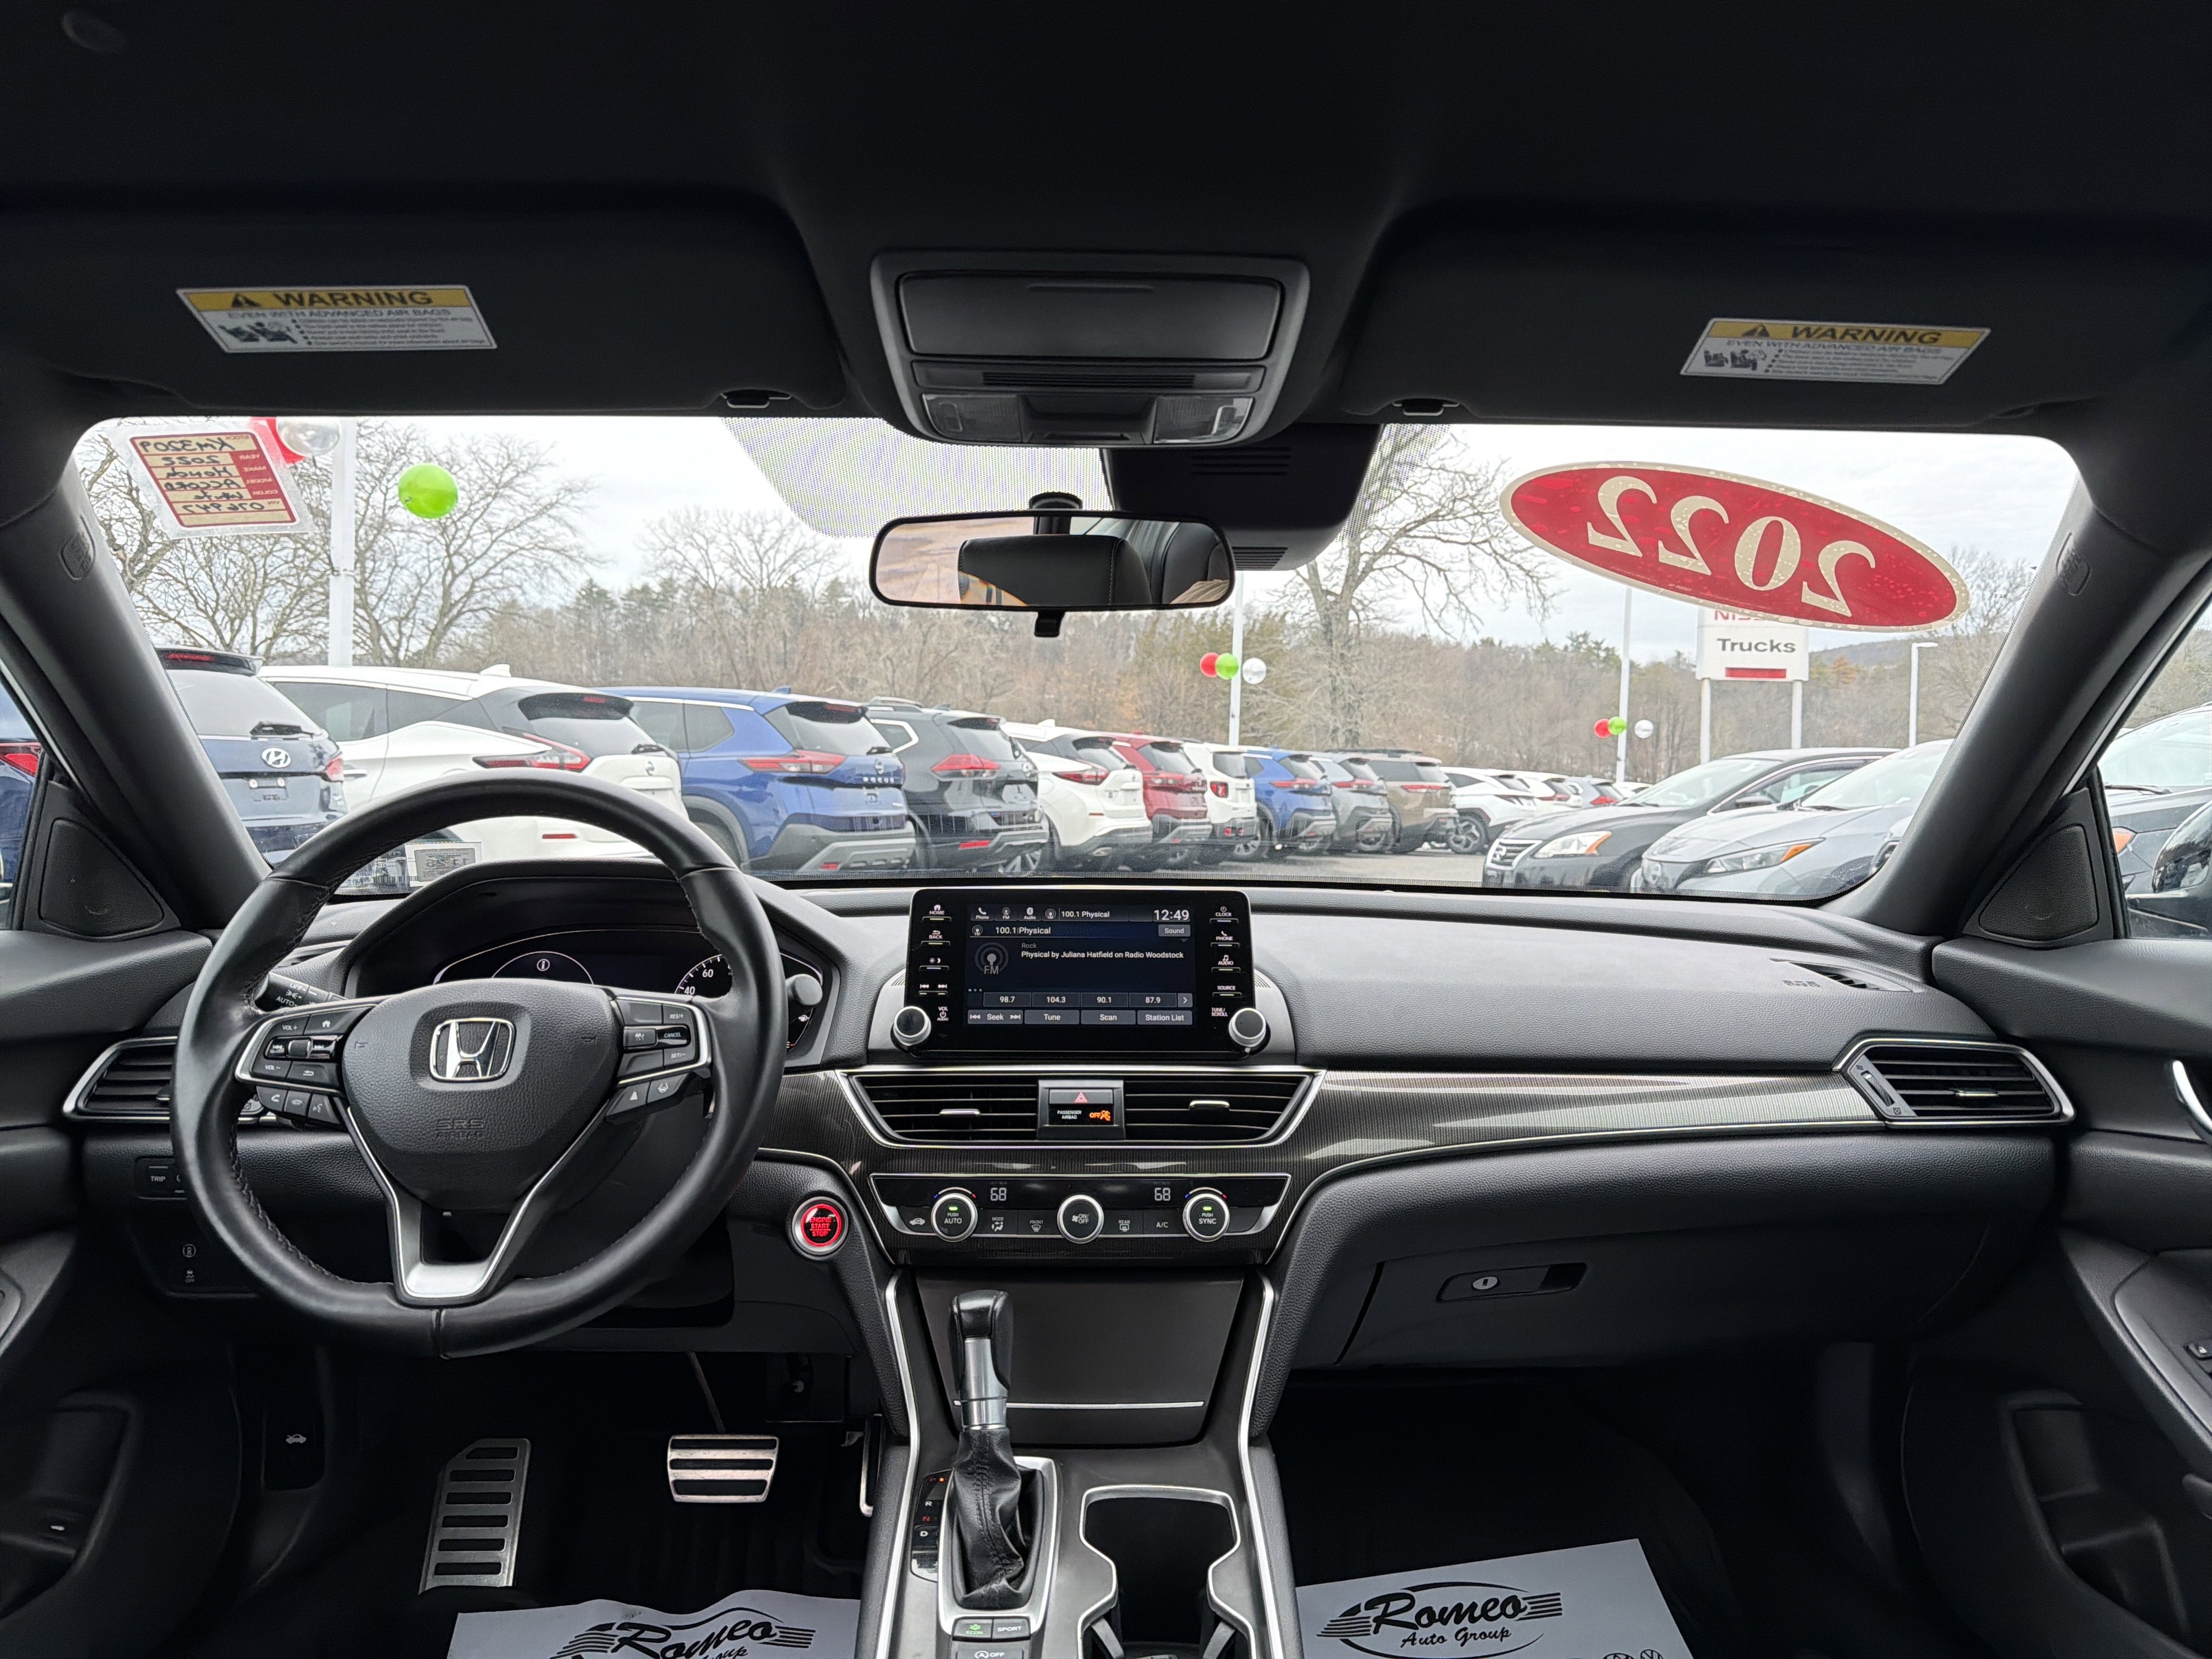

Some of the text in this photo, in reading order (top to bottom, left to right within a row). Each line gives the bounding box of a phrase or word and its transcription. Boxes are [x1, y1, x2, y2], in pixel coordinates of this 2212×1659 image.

[273, 291, 433, 306] WARNING
[228, 311, 267, 319] EVEN
[270, 311, 306, 319] WITH
[309, 309, 384, 318] ADVANCED
[1790, 326, 1943, 345] WARNING
[1798, 342, 1876, 351] ADVANCED
[1717, 638, 1796, 653] Trucks
[1081, 910, 1110, 919] Physical
[1154, 910, 1189, 921] 12:49
[1019, 927, 1051, 936] Physical
[1021, 951, 1050, 960] Physical
[1051, 951, 1059, 960] by
[702, 969, 714, 978] 60
[984, 966, 999, 974] FM
[684, 986, 696, 995] 40
[275, 996, 295, 1006] AUTO
[437, 1118, 484, 1130] SRS
[990, 1187, 1007, 1201] 68
[1154, 1187, 1171, 1201] 68
[1364, 1592, 1527, 1635] Romeo
[611, 1619, 776, 1659] Romeo
[1400, 1626, 1513, 1649] Auto Group
